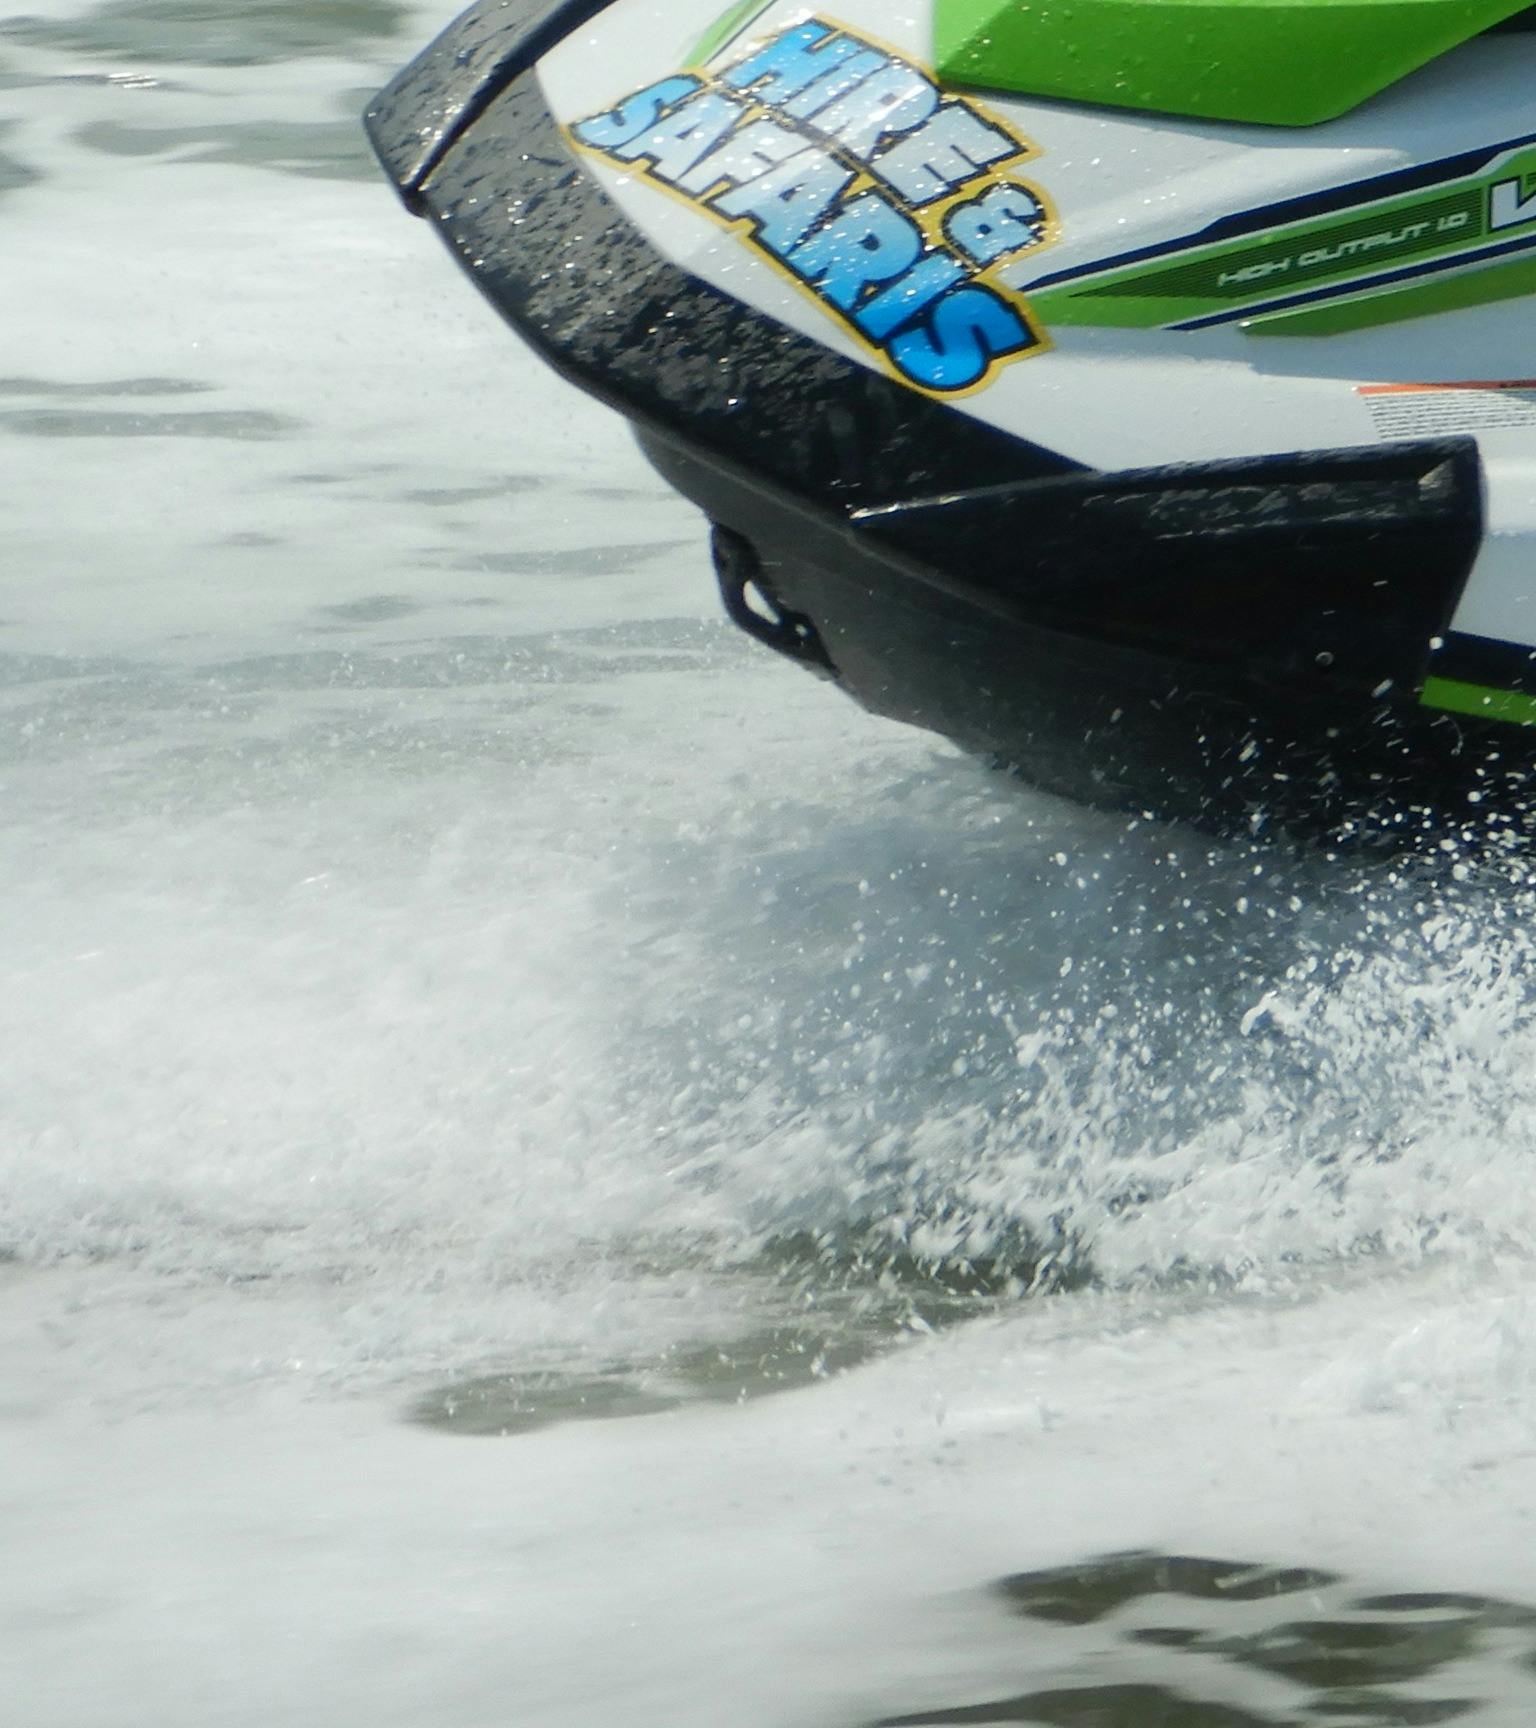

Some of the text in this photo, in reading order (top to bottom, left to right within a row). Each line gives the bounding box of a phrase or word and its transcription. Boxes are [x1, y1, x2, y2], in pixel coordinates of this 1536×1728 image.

[567, 71, 1041, 392] SAFARIS
[722, 17, 1049, 271] HIRE &
[1296, 221, 1431, 267] OUTPUT
